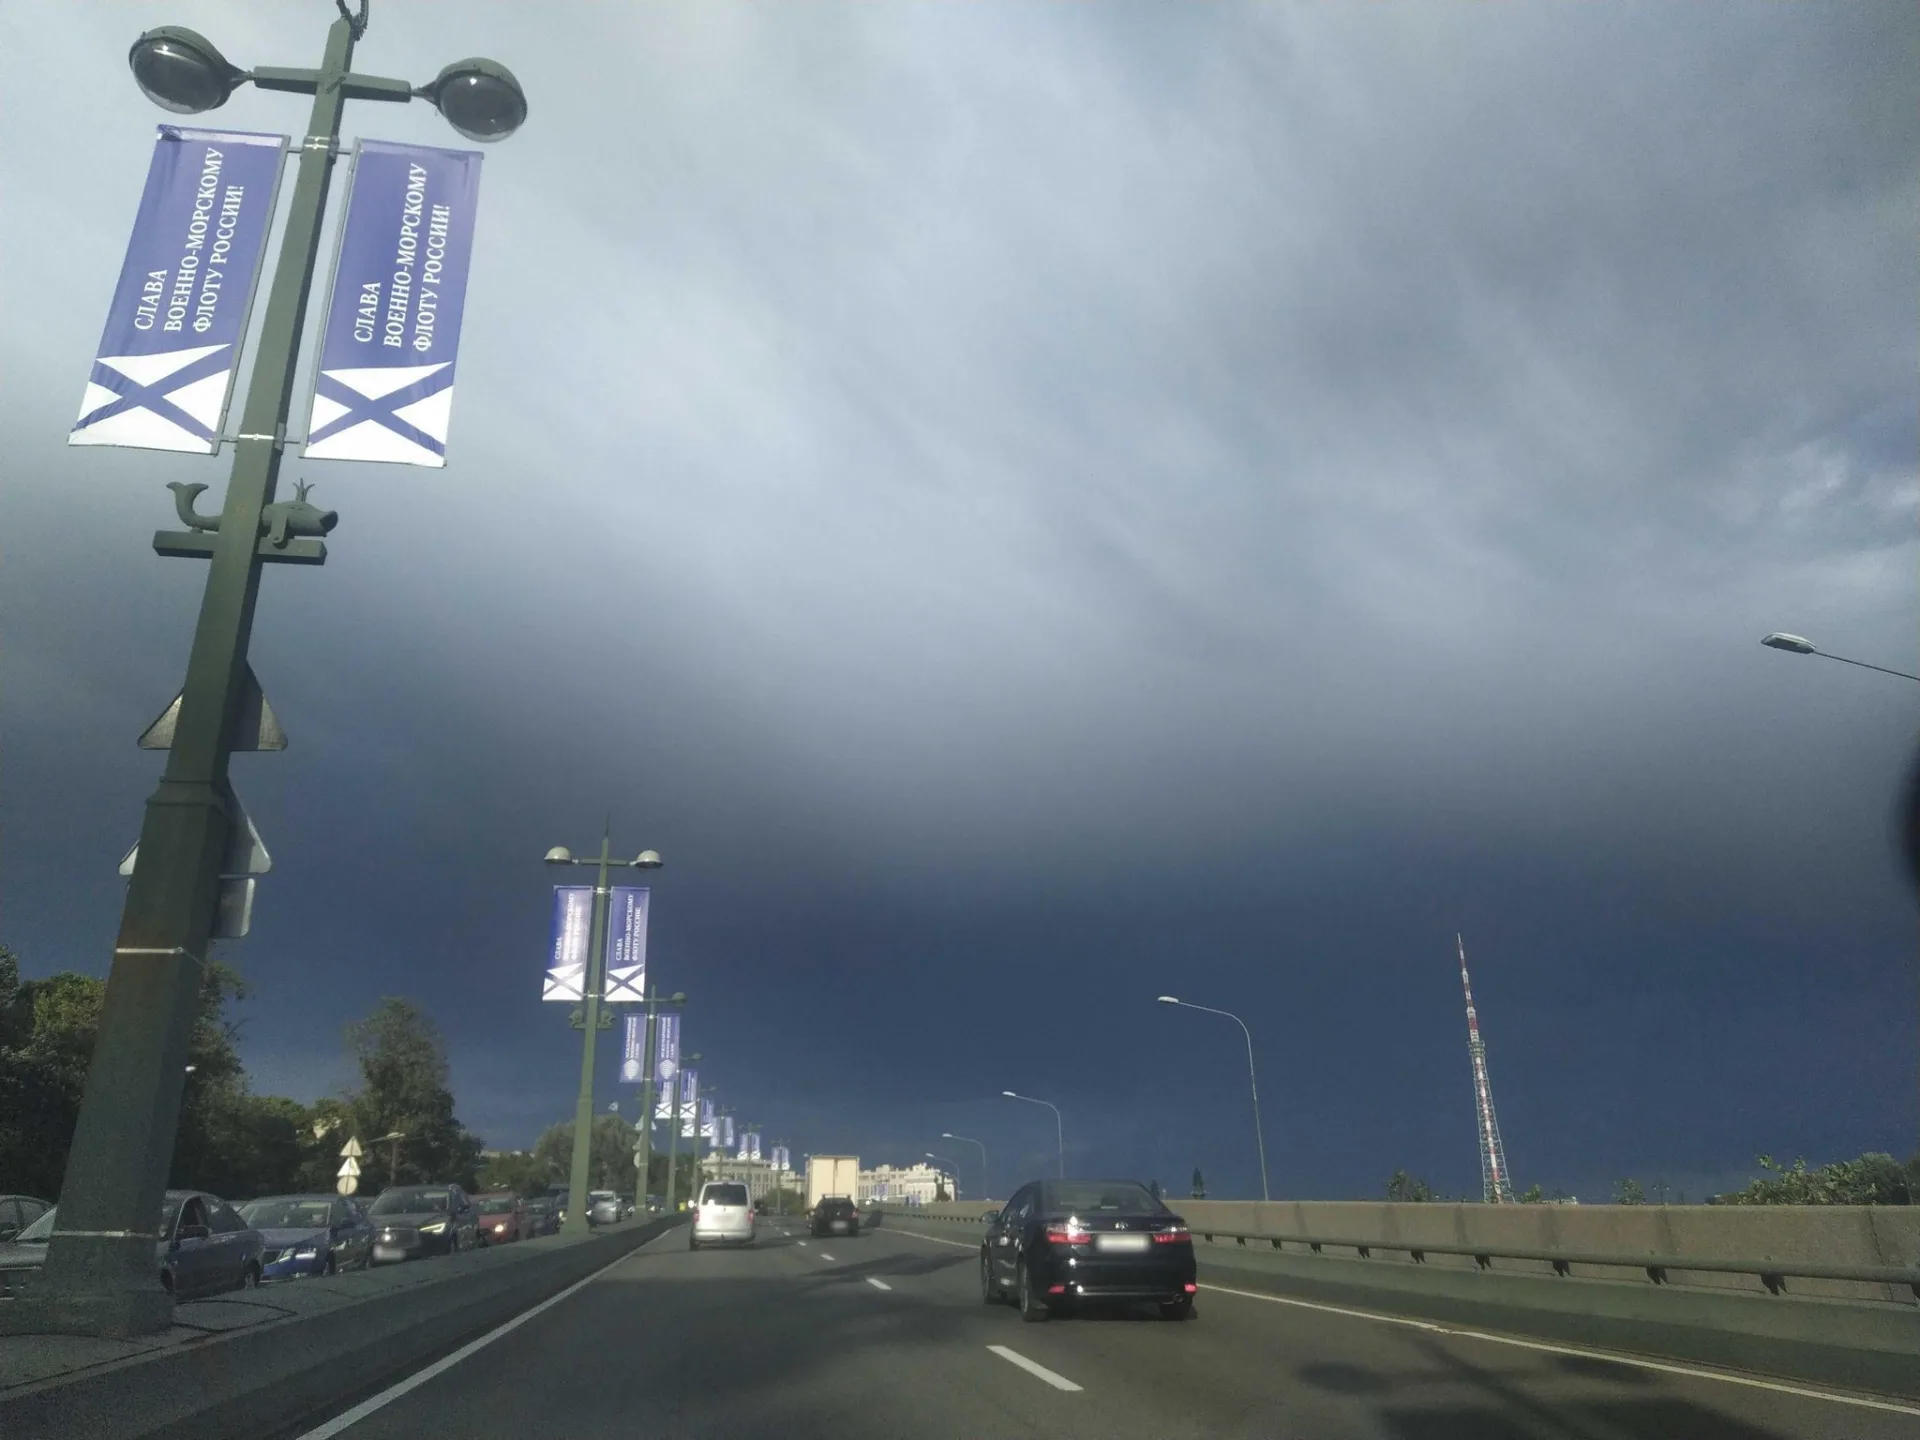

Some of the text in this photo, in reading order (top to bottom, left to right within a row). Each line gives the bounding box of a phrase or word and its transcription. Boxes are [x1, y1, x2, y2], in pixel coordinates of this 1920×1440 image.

[134, 269, 167, 330] СЛАВА
[163, 147, 224, 332] ВОЕННО-МОРСКОМУ
[192, 185, 244, 332] ФЛОТУ РОССИИ!
[354, 281, 381, 342] СЛАВА
[383, 162, 428, 348] ВОЕННО-МОРСКОМУ
[413, 204, 450, 352] ФЛОТУ РОССИИ!
